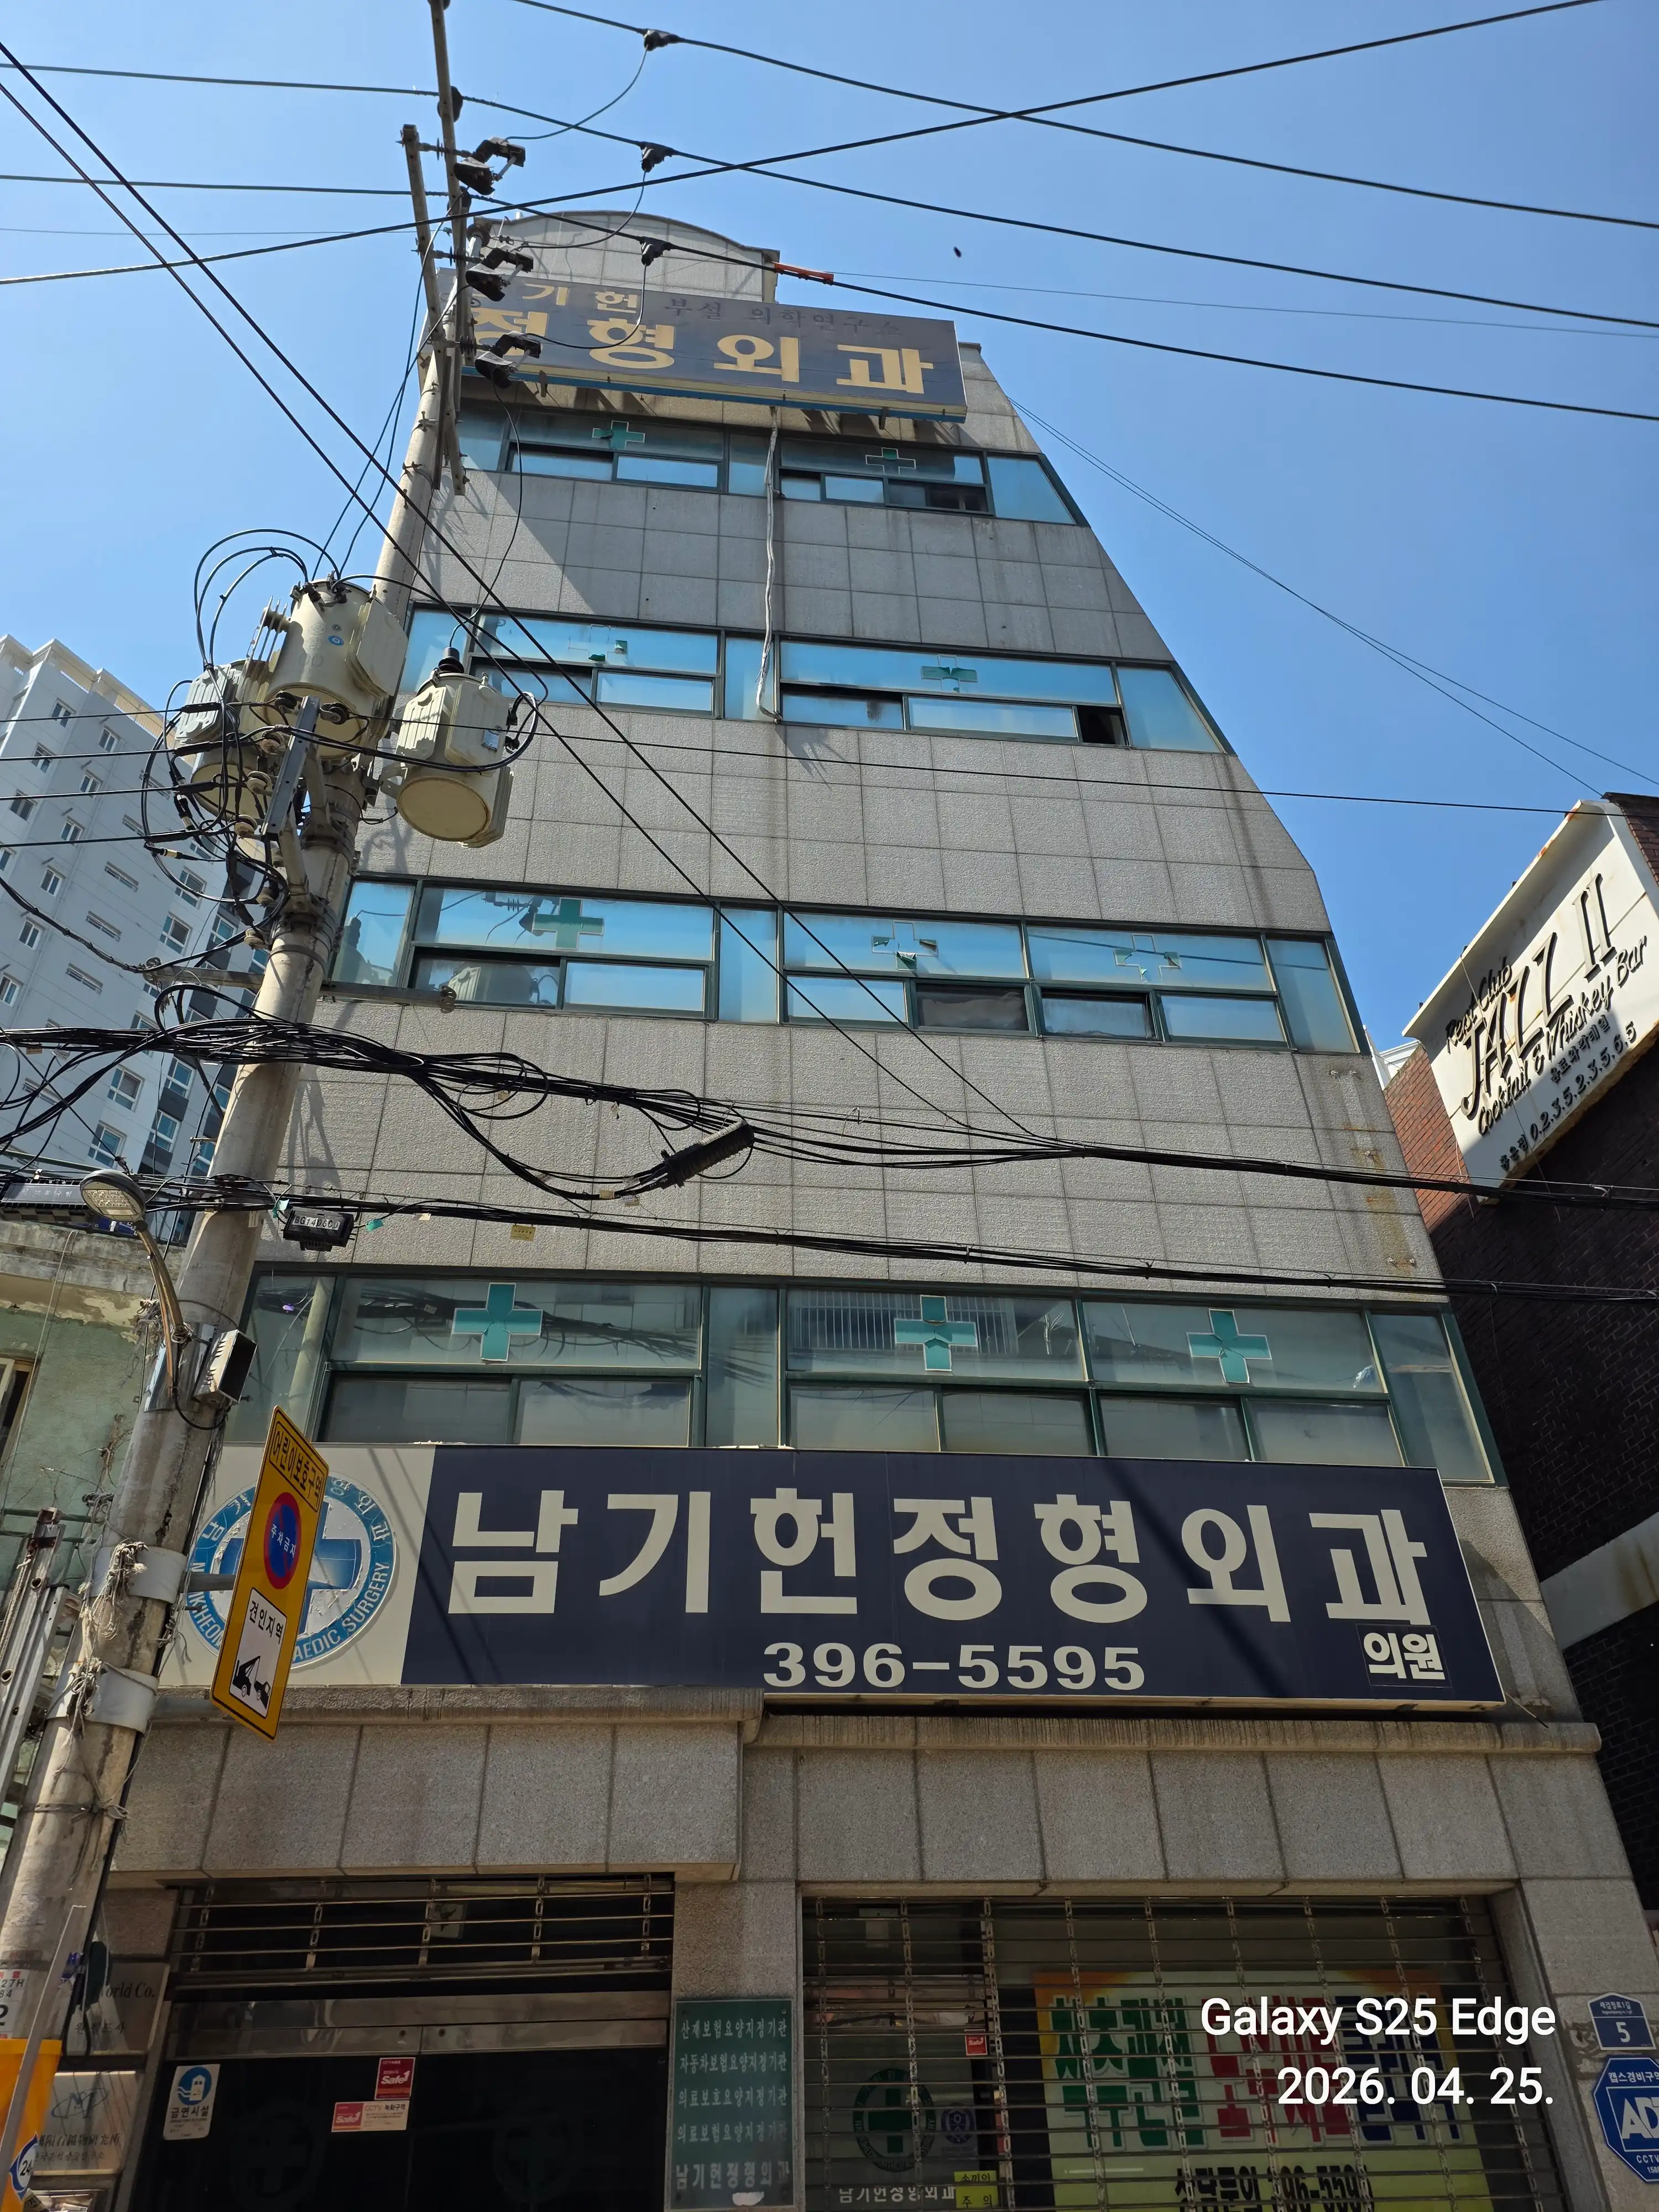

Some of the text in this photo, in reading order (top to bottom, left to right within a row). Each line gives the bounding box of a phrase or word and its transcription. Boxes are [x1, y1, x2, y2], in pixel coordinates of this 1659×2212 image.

[665, 298, 721, 320] 부설
[749, 306, 901, 336] 의학연구소
[471, 307, 933, 394] 정형외과
[1478, 956, 1512, 1011] Club
[1460, 932, 1574, 1120] JAZZ
[1478, 935, 1647, 1135] Cocktail & Whiskey Bar
[273, 1431, 323, 1507] 어린이보호구역
[270, 1524, 296, 1558] 주차금지
[448, 1488, 1431, 1625] 남기헌정형외과
[249, 1600, 284, 1645] 견인지역
[293, 1629, 341, 1661] AEDIC
[342, 1562, 390, 1633] SURGERY
[764, 1642, 1145, 1690] 396-5595
[1363, 1631, 1445, 1681] 의원
[101, 1981, 155, 1998] orld Co.
[681, 2017, 787, 2039] 산재보험요양지정기관
[1615, 2021, 1631, 2043] 5
[680, 2051, 787, 2074] 자동차보험요양지정기관
[171, 2104, 209, 2119] 금연시설
[678, 2085, 787, 2110] 의료보호요양지정기관
[677, 2120, 787, 2144] 의료보험요양지정기관
[676, 2161, 790, 2190] 남기헌정형외과
[961, 2193, 993, 2209] 주의
